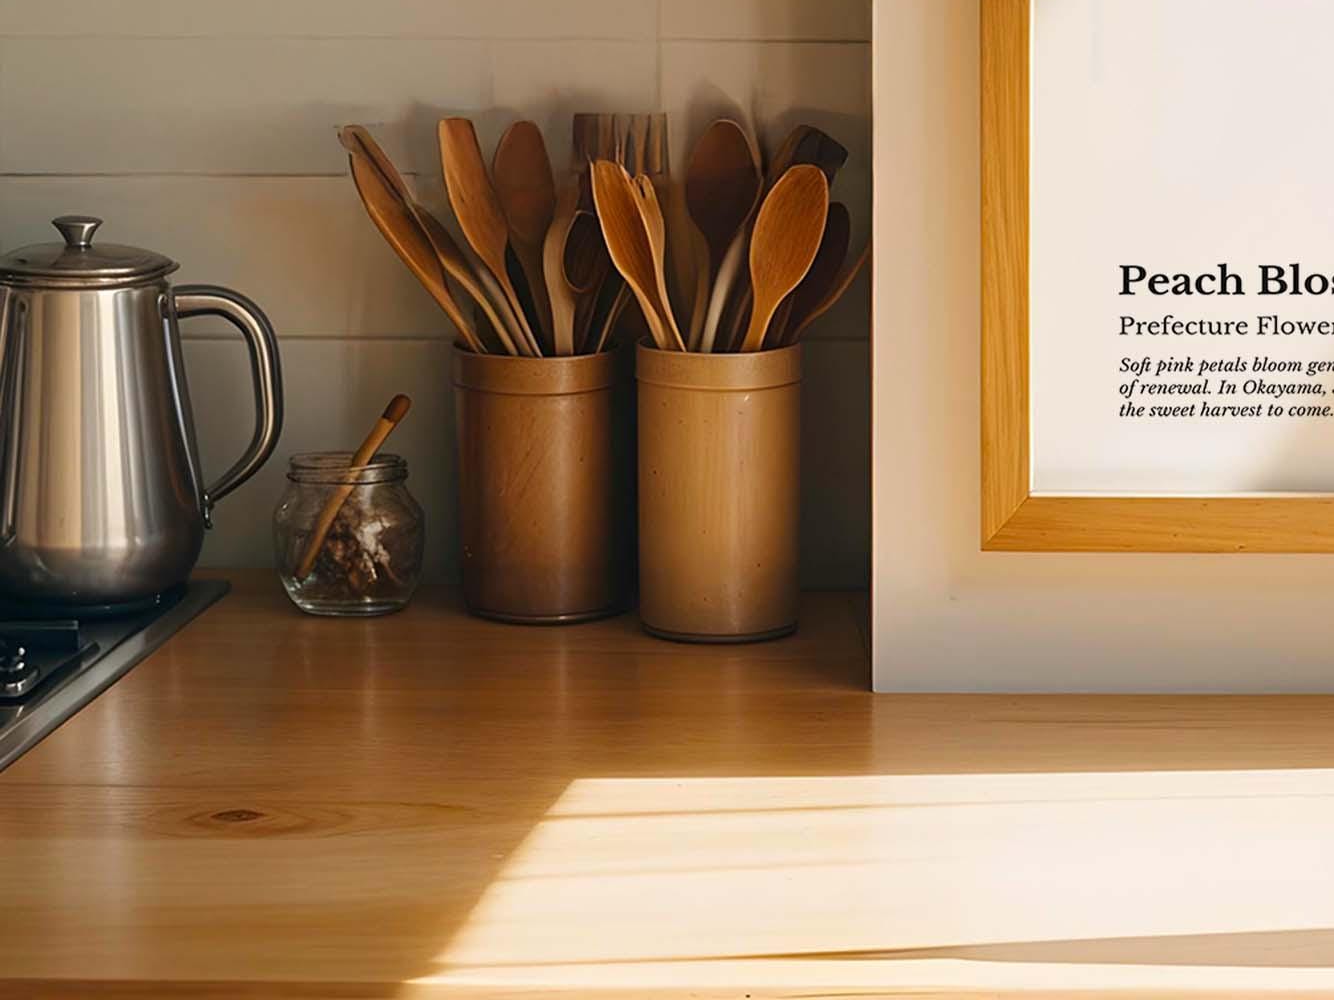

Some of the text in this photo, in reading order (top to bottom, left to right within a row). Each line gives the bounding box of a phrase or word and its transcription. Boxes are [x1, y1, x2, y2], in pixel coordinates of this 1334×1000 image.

[1118, 262, 1246, 296] Peach
[1118, 314, 1249, 336] Prefecture
[1119, 356, 1151, 377] Soft
[1155, 356, 1195, 376] pink
[1198, 356, 1248, 376] petals
[1252, 356, 1302, 373] bloom
[1119, 378, 1139, 399] of
[1139, 378, 1212, 395] renewal.
[1217, 379, 1237, 395] In
[1242, 378, 1327, 399] Okayama,
[1119, 401, 1334, 417] the sweet harvest to come.
